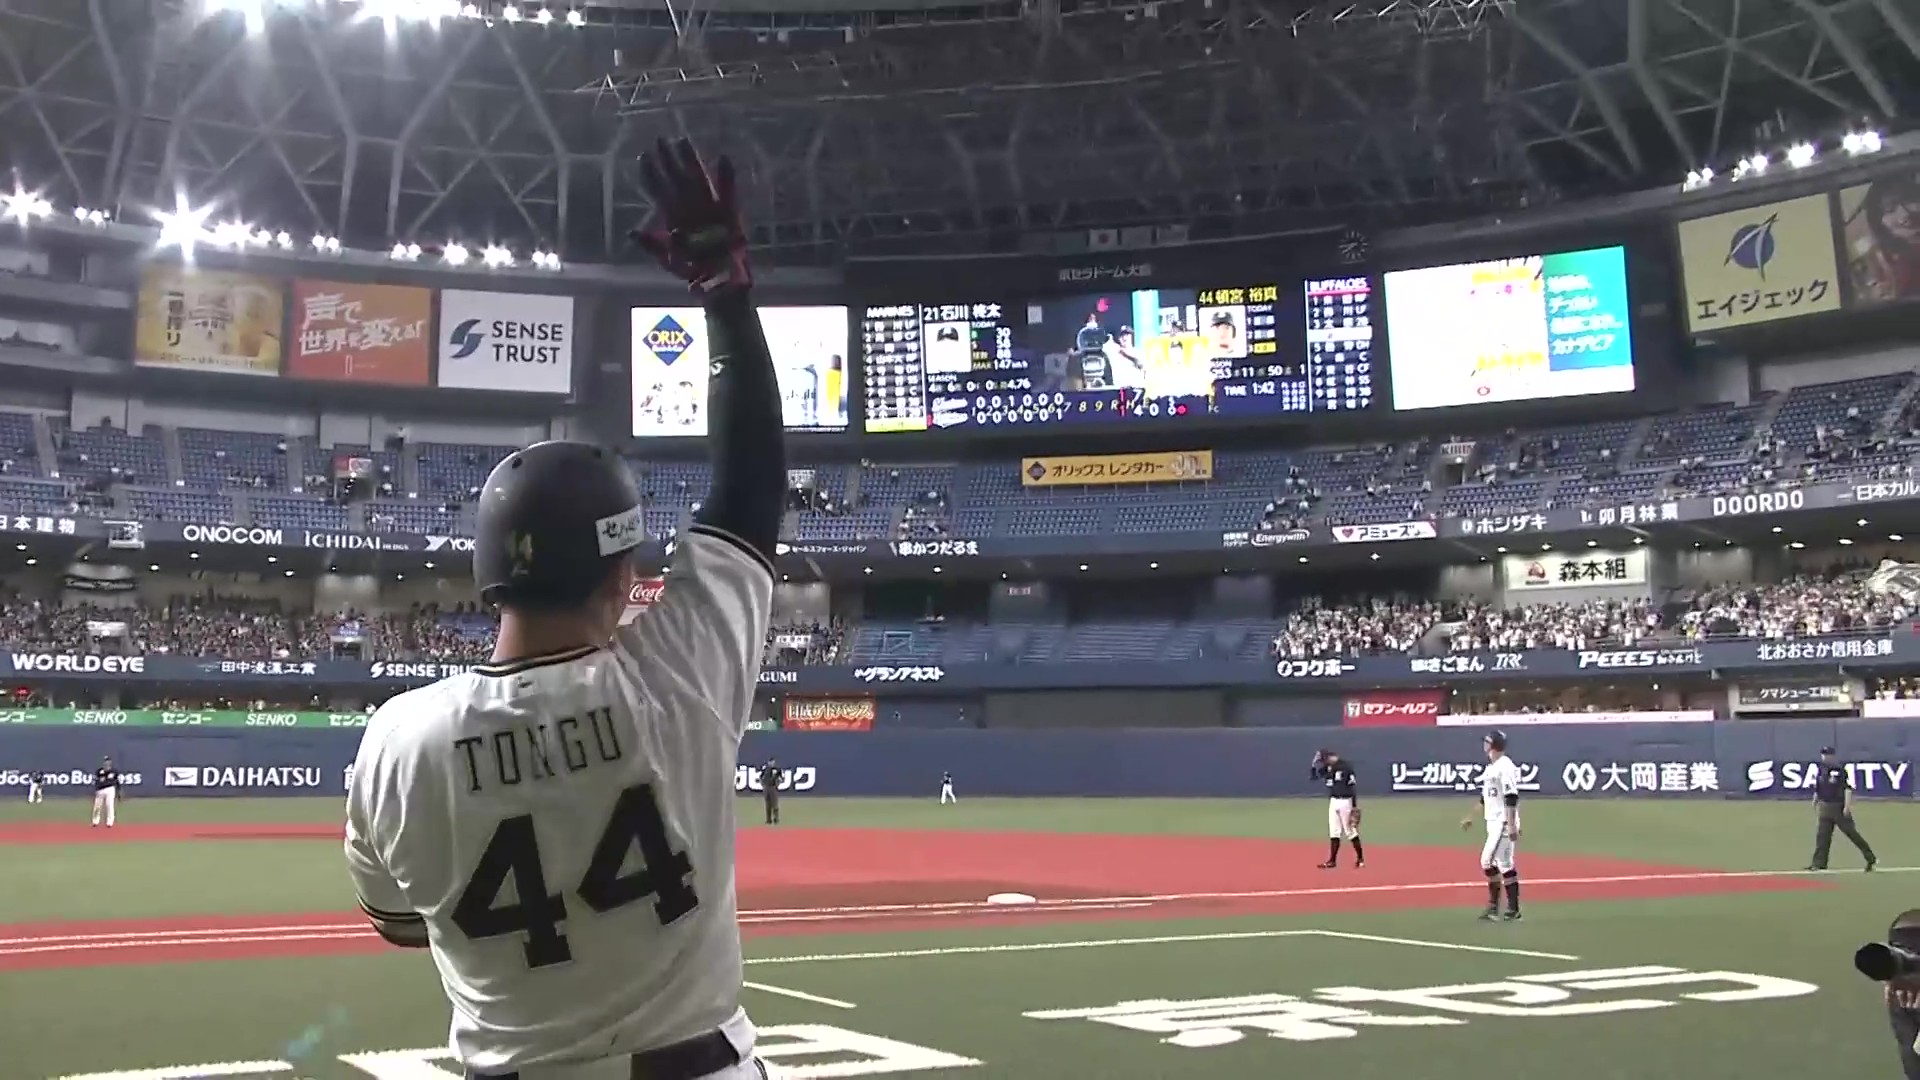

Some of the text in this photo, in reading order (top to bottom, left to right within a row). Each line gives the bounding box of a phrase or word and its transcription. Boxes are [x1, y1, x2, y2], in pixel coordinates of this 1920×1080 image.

[1310, 278, 1367, 292] BUFFALOES
[1199, 291, 1213, 304] 44
[1697, 279, 1828, 320] エイジェック
[924, 307, 938, 320] 21
[940, 305, 969, 320] 石川
[492, 321, 563, 341] SENSE
[648, 330, 686, 345] ORIX
[493, 343, 562, 364] TRUST
[1225, 382, 1275, 396] TIME 1:42
[1053, 463, 1105, 477] オリックス
[1110, 461, 1165, 475] レンタカー
[1713, 490, 1803, 516] DOORDO
[1476, 514, 1548, 534] ホシザキ
[182, 524, 283, 546] ONOCOM
[304, 530, 381, 550] ICHIDAI
[1256, 532, 1306, 544] Energywith
[898, 539, 979, 557] 串かつだるま
[1559, 558, 1628, 584] 森本組
[1757, 639, 1894, 661] 北おおさか信用金庫
[386, 663, 437, 679] SENSE
[755, 671, 797, 683] GUMI
[73, 711, 127, 725] SENKO
[161, 712, 212, 725] センコー
[245, 713, 297, 727] SENKO
[454, 706, 623, 792] TONGU
[0, 770, 142, 786] docmo Buess
[202, 766, 321, 788] DAIHATSU
[1392, 763, 1539, 784] リーガルマンン
[1601, 761, 1720, 792] 大岡産業
[1781, 762, 1908, 790] SAITY
[451, 783, 700, 970] 44
